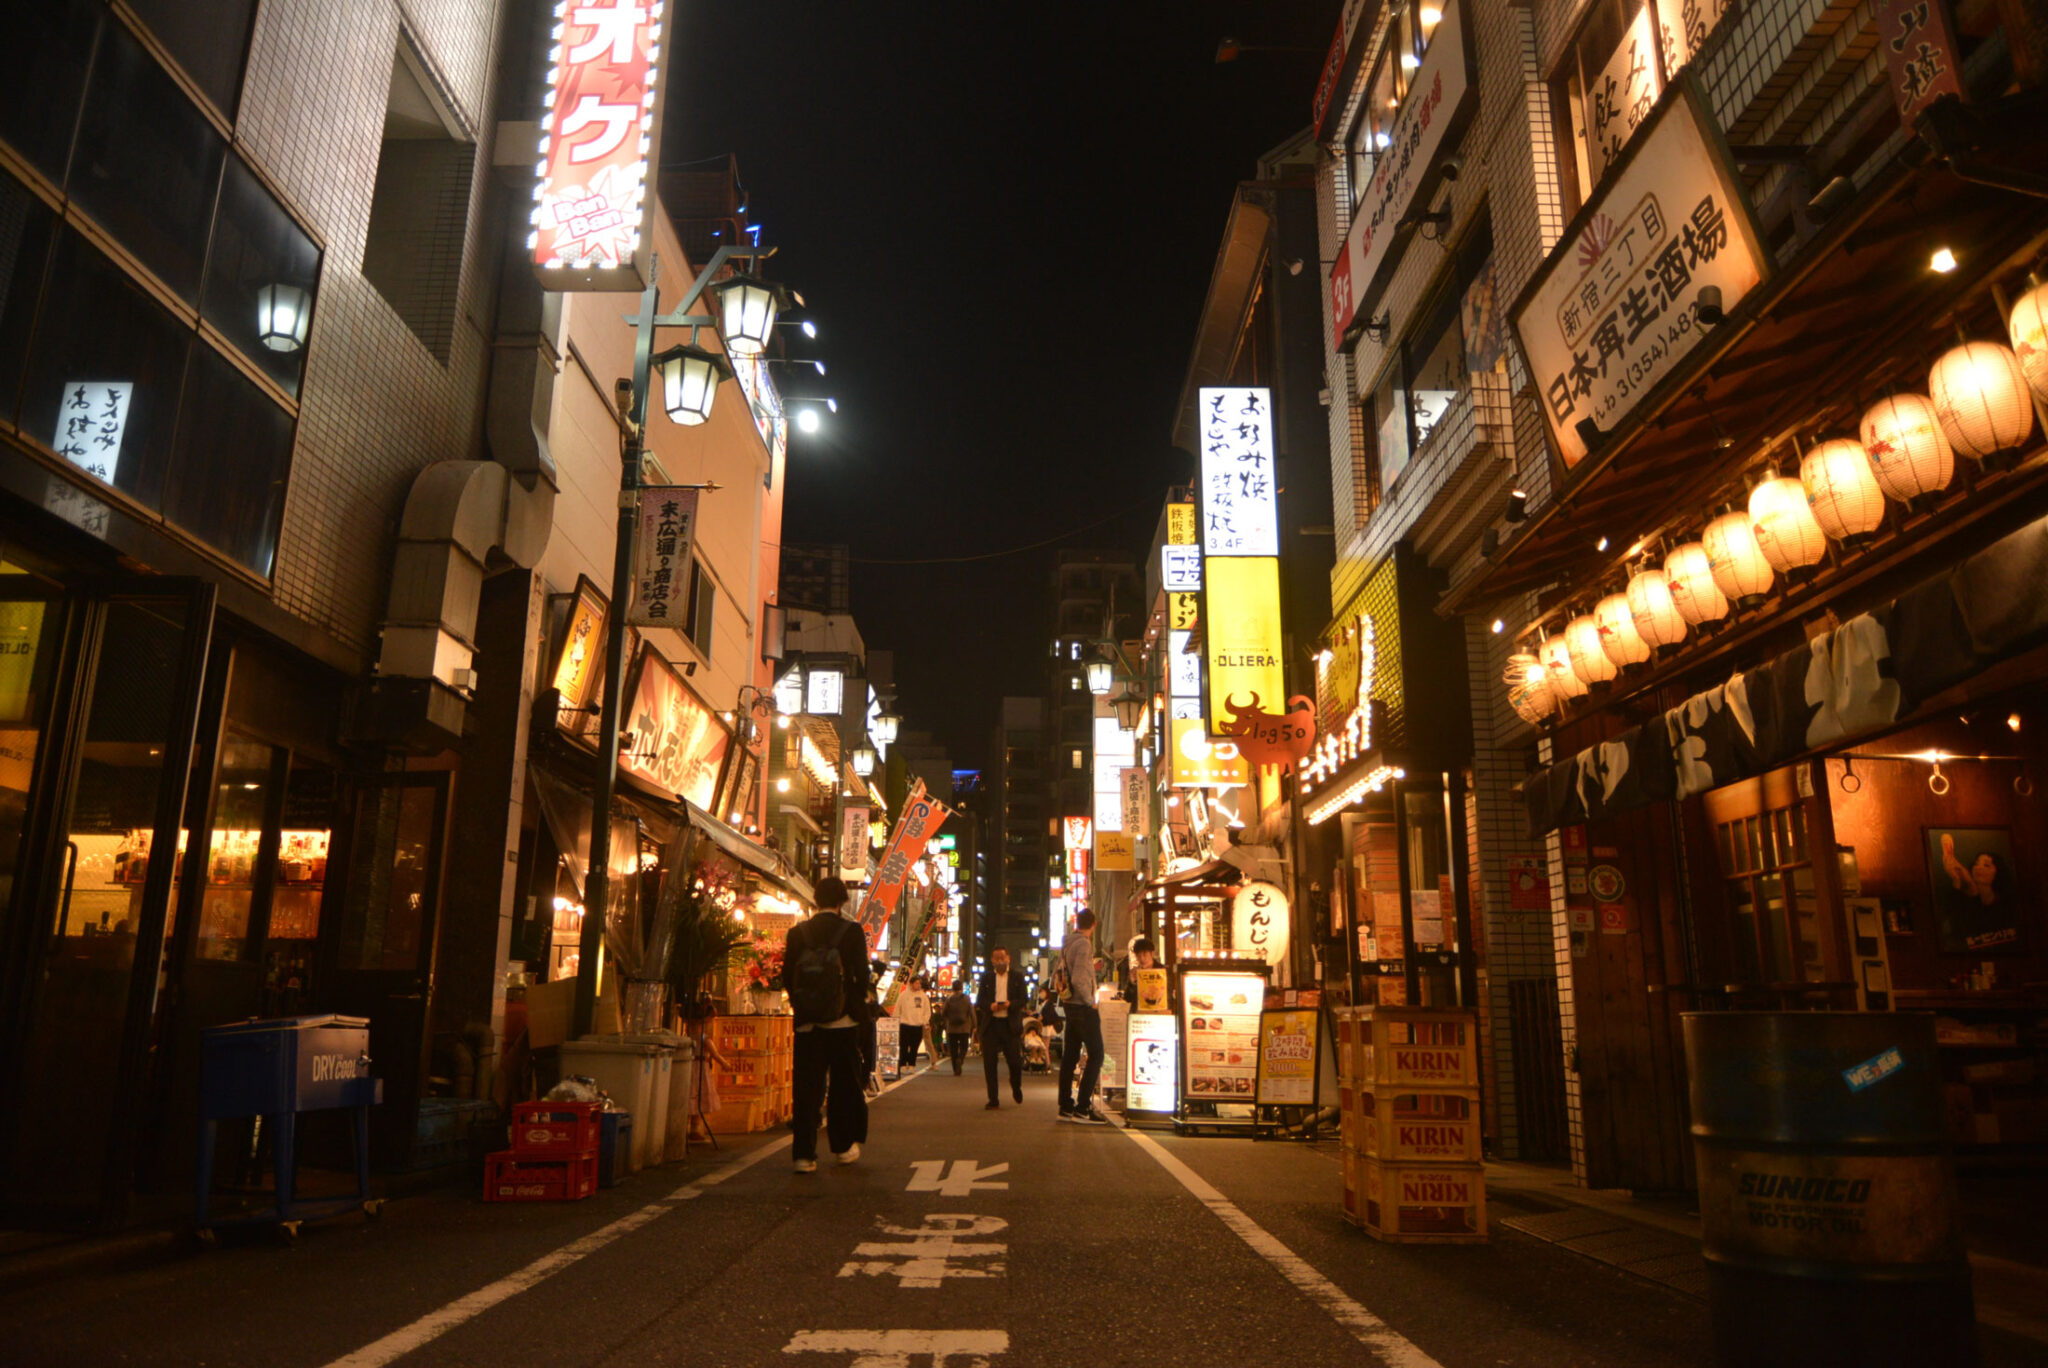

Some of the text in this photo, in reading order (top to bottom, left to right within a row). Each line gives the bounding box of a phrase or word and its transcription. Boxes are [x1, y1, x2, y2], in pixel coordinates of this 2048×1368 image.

[552, 194, 608, 224] Ban
[568, 209, 623, 239] Ban
[1563, 203, 1662, 338] 新宿三丁目
[1333, 276, 1351, 325] 3F
[1547, 194, 1728, 427] 日本再生酒場
[1207, 394, 1231, 457] もんじゃ
[1217, 655, 1276, 668] OLIERA
[722, 1025, 756, 1035] KIRIN
[312, 1054, 358, 1082] DRY COOL
[1395, 1051, 1460, 1071] KIRIN
[1399, 1126, 1464, 1146] KIRIN
[1403, 1183, 1469, 1202] KIRIN
[1738, 1172, 1872, 1204] SUNOCO
[1748, 1211, 1866, 1234] MOTOR OIL
